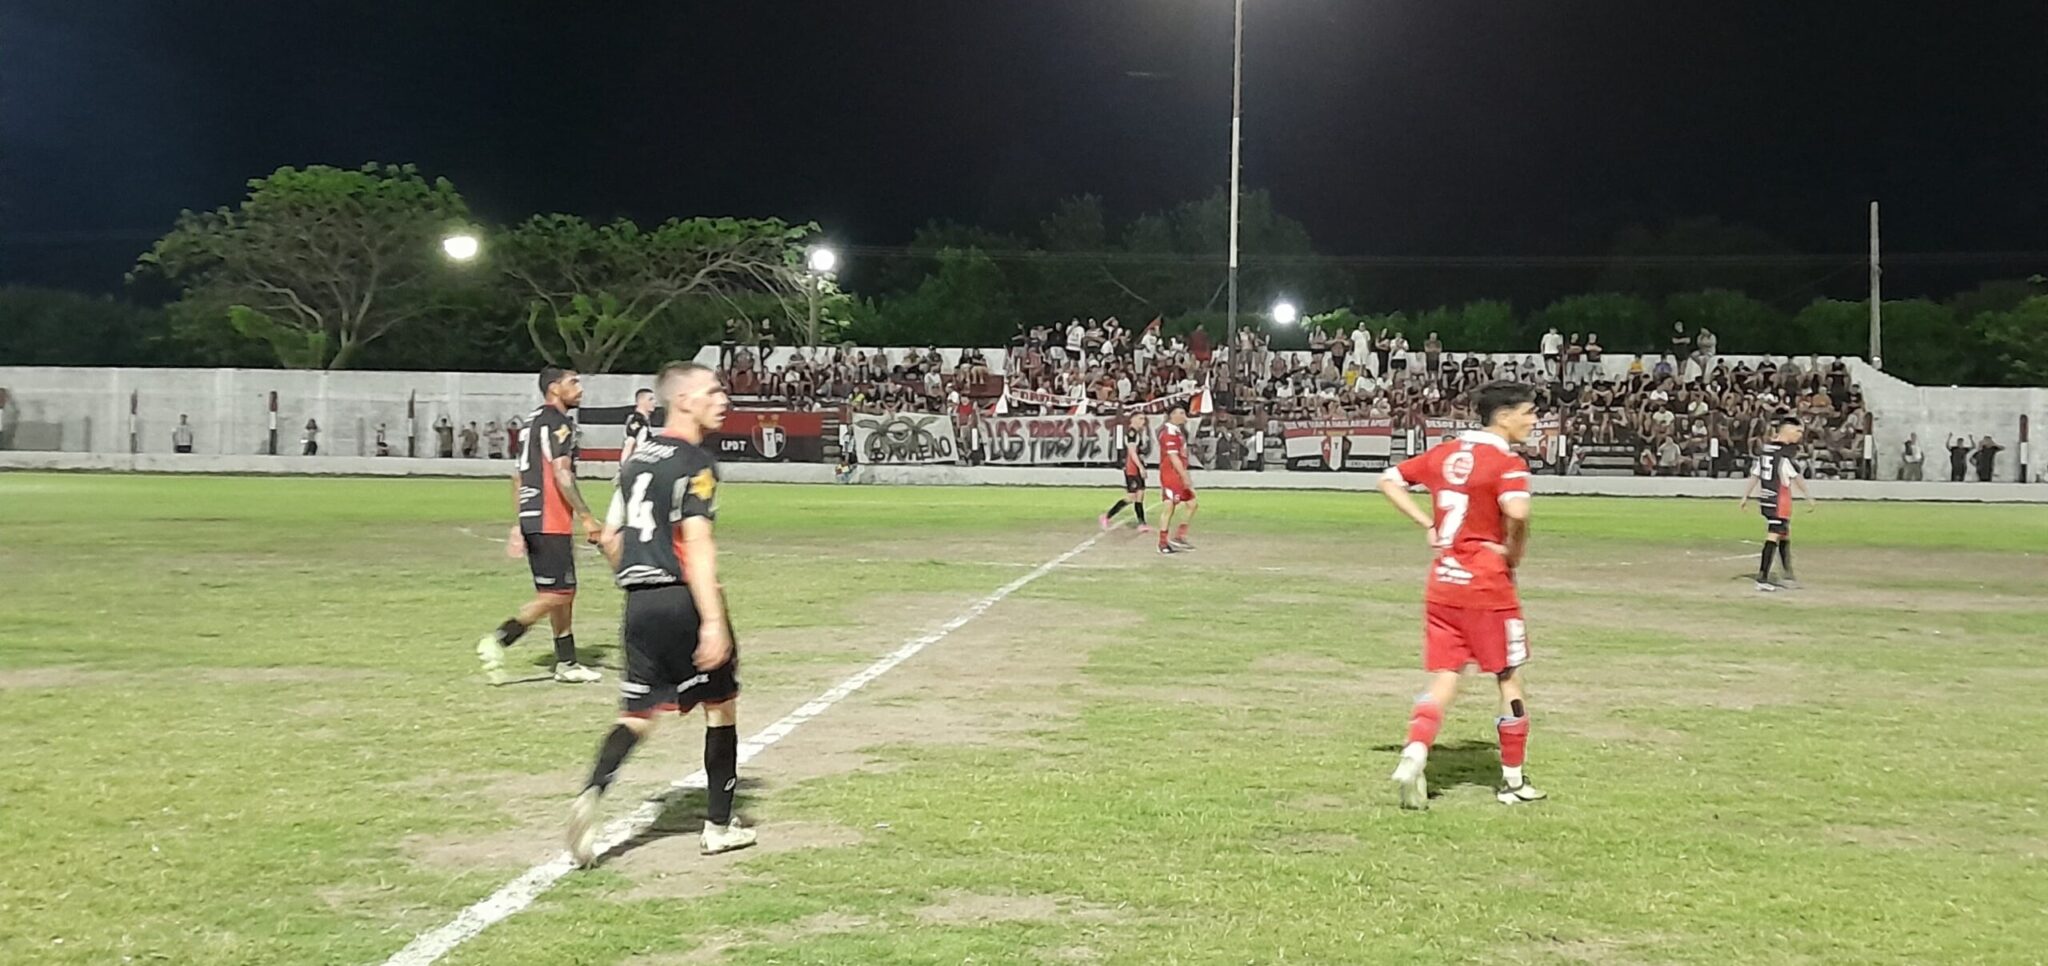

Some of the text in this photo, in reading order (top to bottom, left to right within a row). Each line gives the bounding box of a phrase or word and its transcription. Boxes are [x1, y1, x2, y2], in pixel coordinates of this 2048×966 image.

[721, 440, 747, 451] LPDT
[985, 418, 1025, 461] LOS
[1077, 418, 1102, 461] DE
[1425, 420, 1454, 429] DESDE
[627, 472, 656, 542] 4
[1437, 490, 1469, 548] 7
